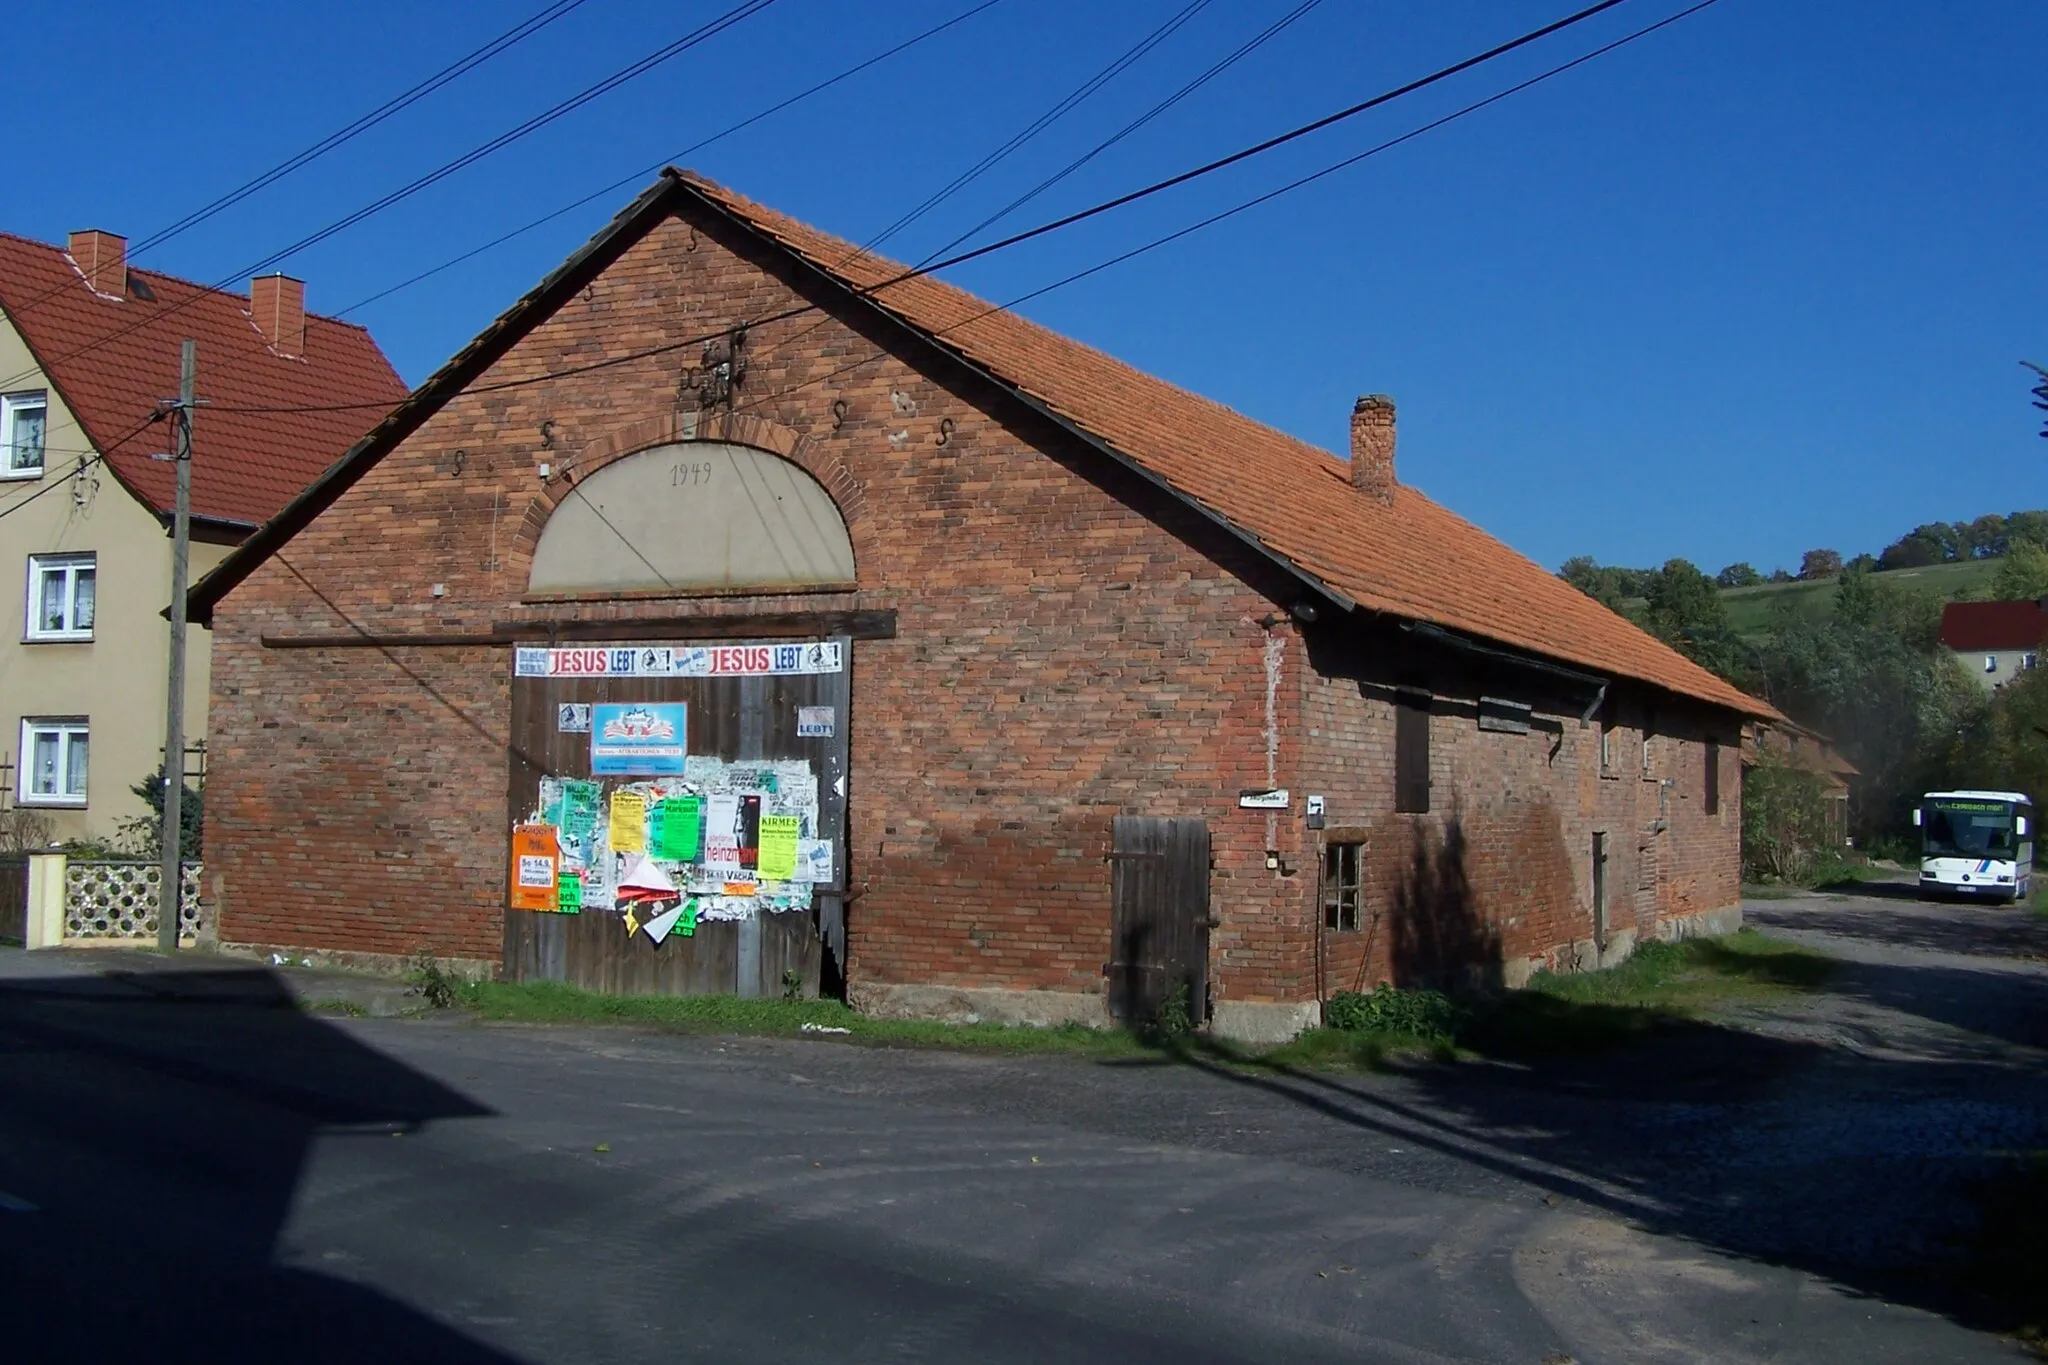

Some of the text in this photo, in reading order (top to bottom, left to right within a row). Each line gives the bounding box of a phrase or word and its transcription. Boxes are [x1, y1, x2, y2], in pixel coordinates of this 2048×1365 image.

[670, 462, 711, 486] 1949
[549, 651, 607, 675] JESUS
[611, 650, 636, 672] LEBT
[709, 648, 770, 674] JESUS
[774, 647, 802, 670] LEBT
[762, 818, 798, 827] KIRMES
[522, 859, 531, 867] So
[706, 843, 759, 863] heinzmann
